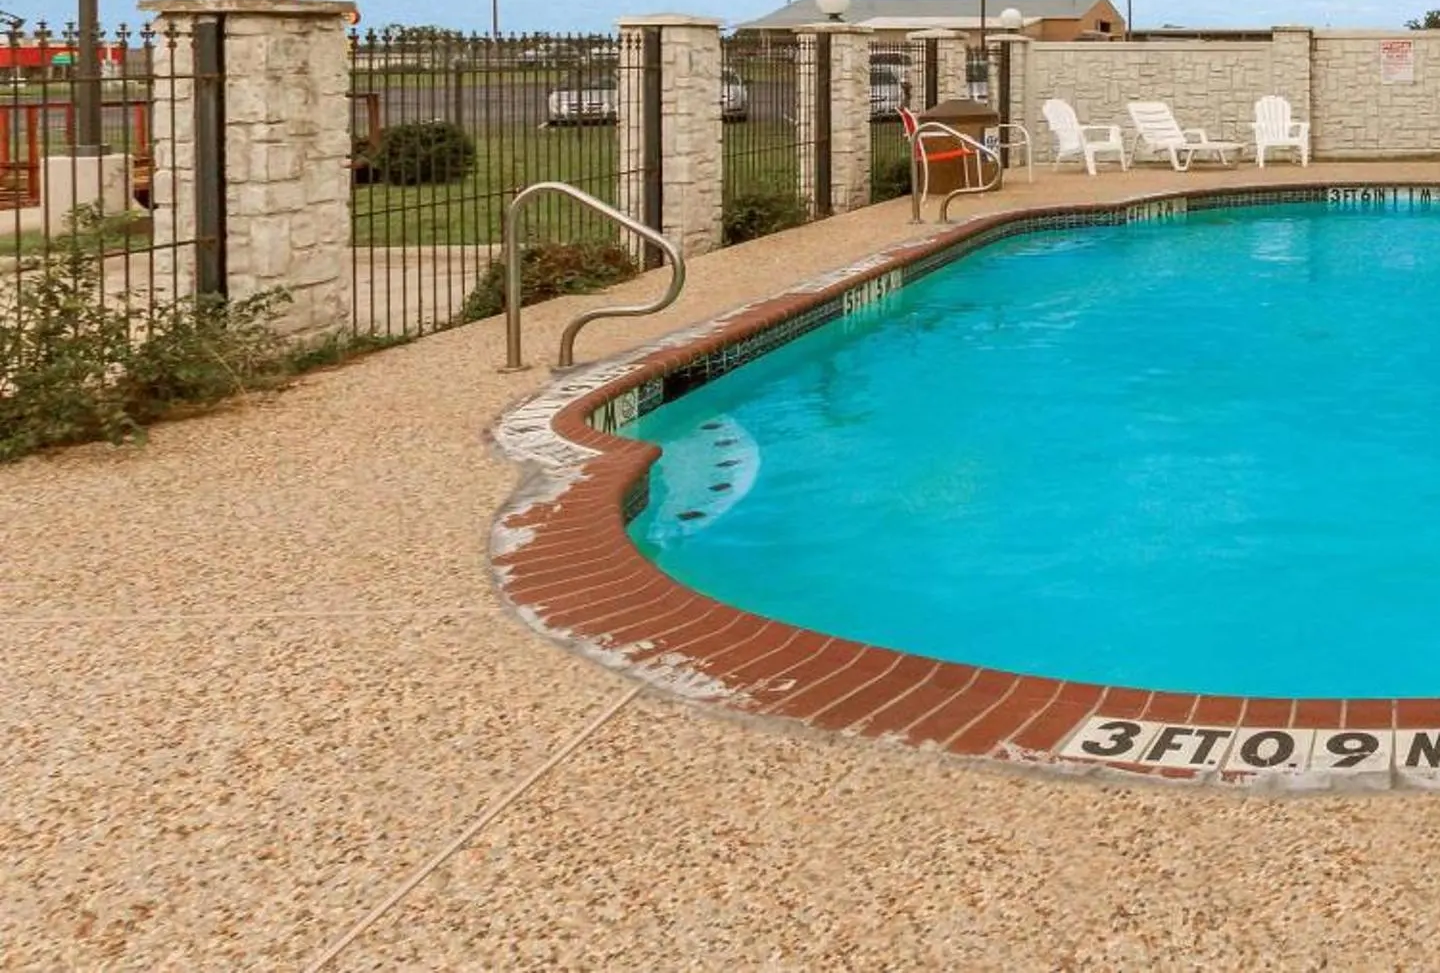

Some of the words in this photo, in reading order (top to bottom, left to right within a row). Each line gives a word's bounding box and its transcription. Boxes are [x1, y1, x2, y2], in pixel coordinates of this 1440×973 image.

[1328, 188, 1339, 200] 3
[1360, 187, 1371, 200] 6
[1080, 720, 1141, 757] 3
